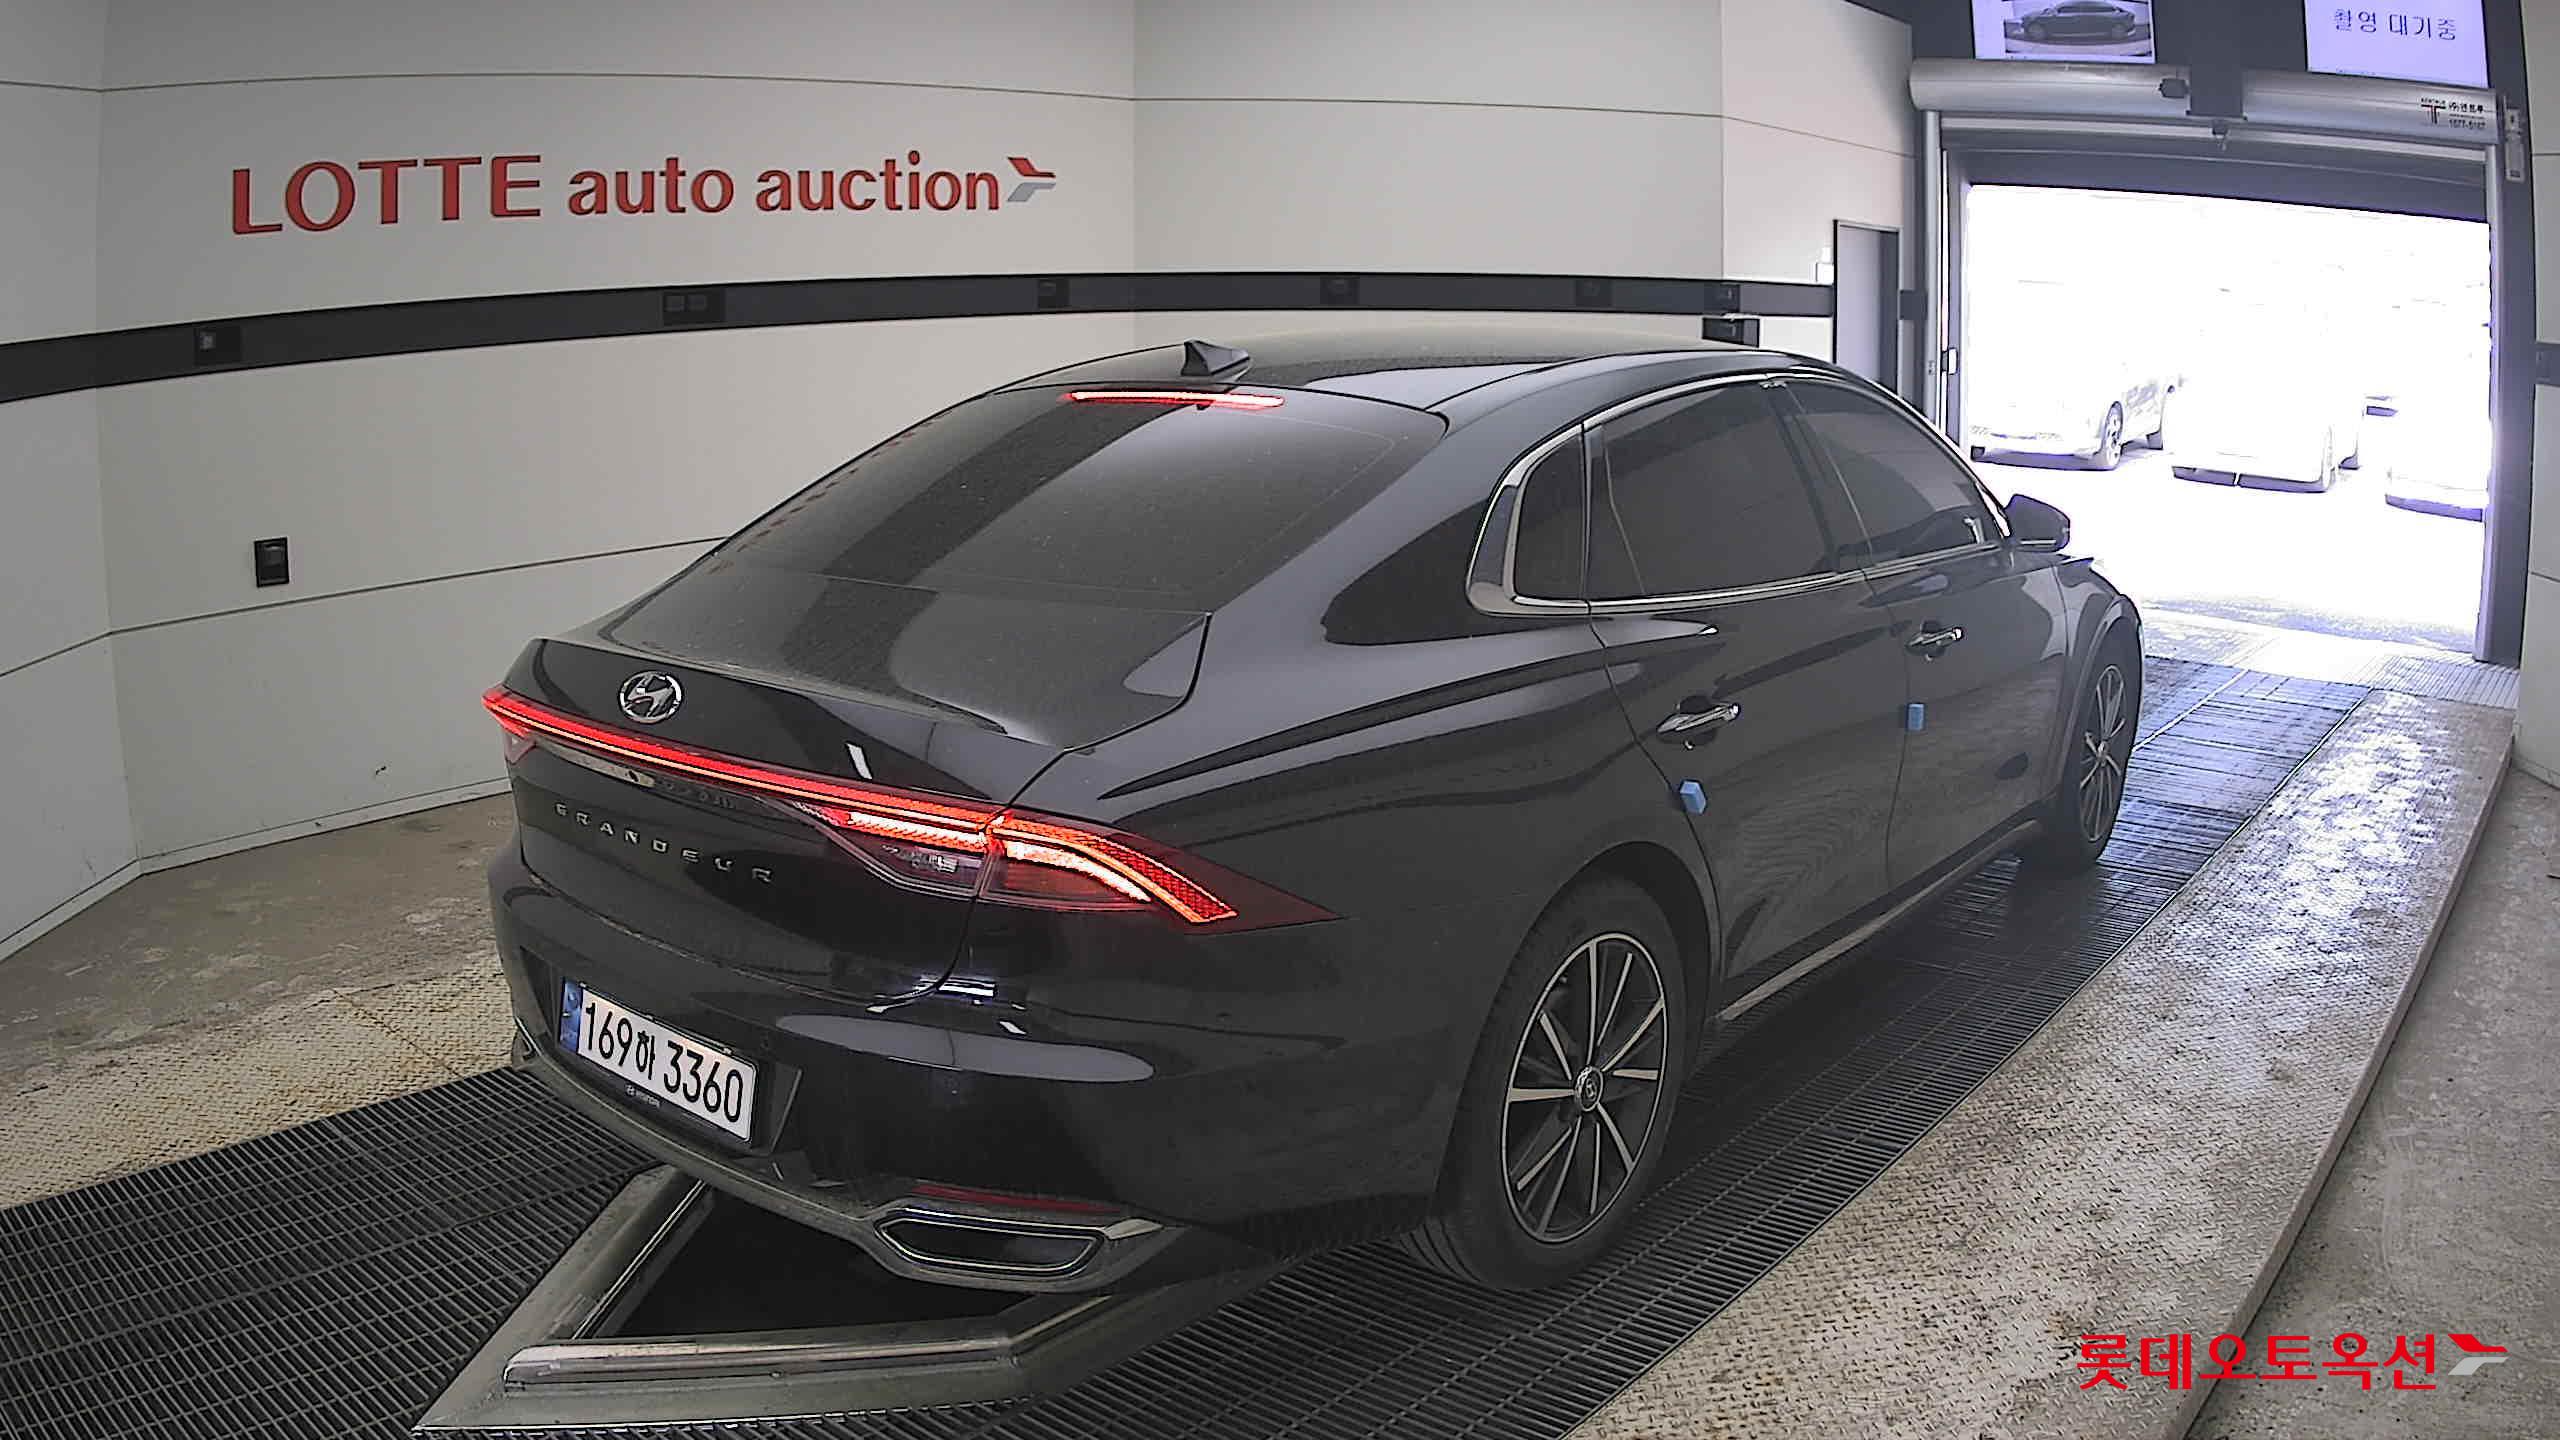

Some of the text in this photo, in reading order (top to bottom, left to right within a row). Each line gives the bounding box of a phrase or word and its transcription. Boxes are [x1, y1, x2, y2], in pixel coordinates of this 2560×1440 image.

[2388, 14, 2457, 41] 대기중
[232, 150, 1001, 235] LOTTE auto auction
[553, 802, 775, 884] GRANDEUR
[585, 1002, 744, 1123] 169하 3360
